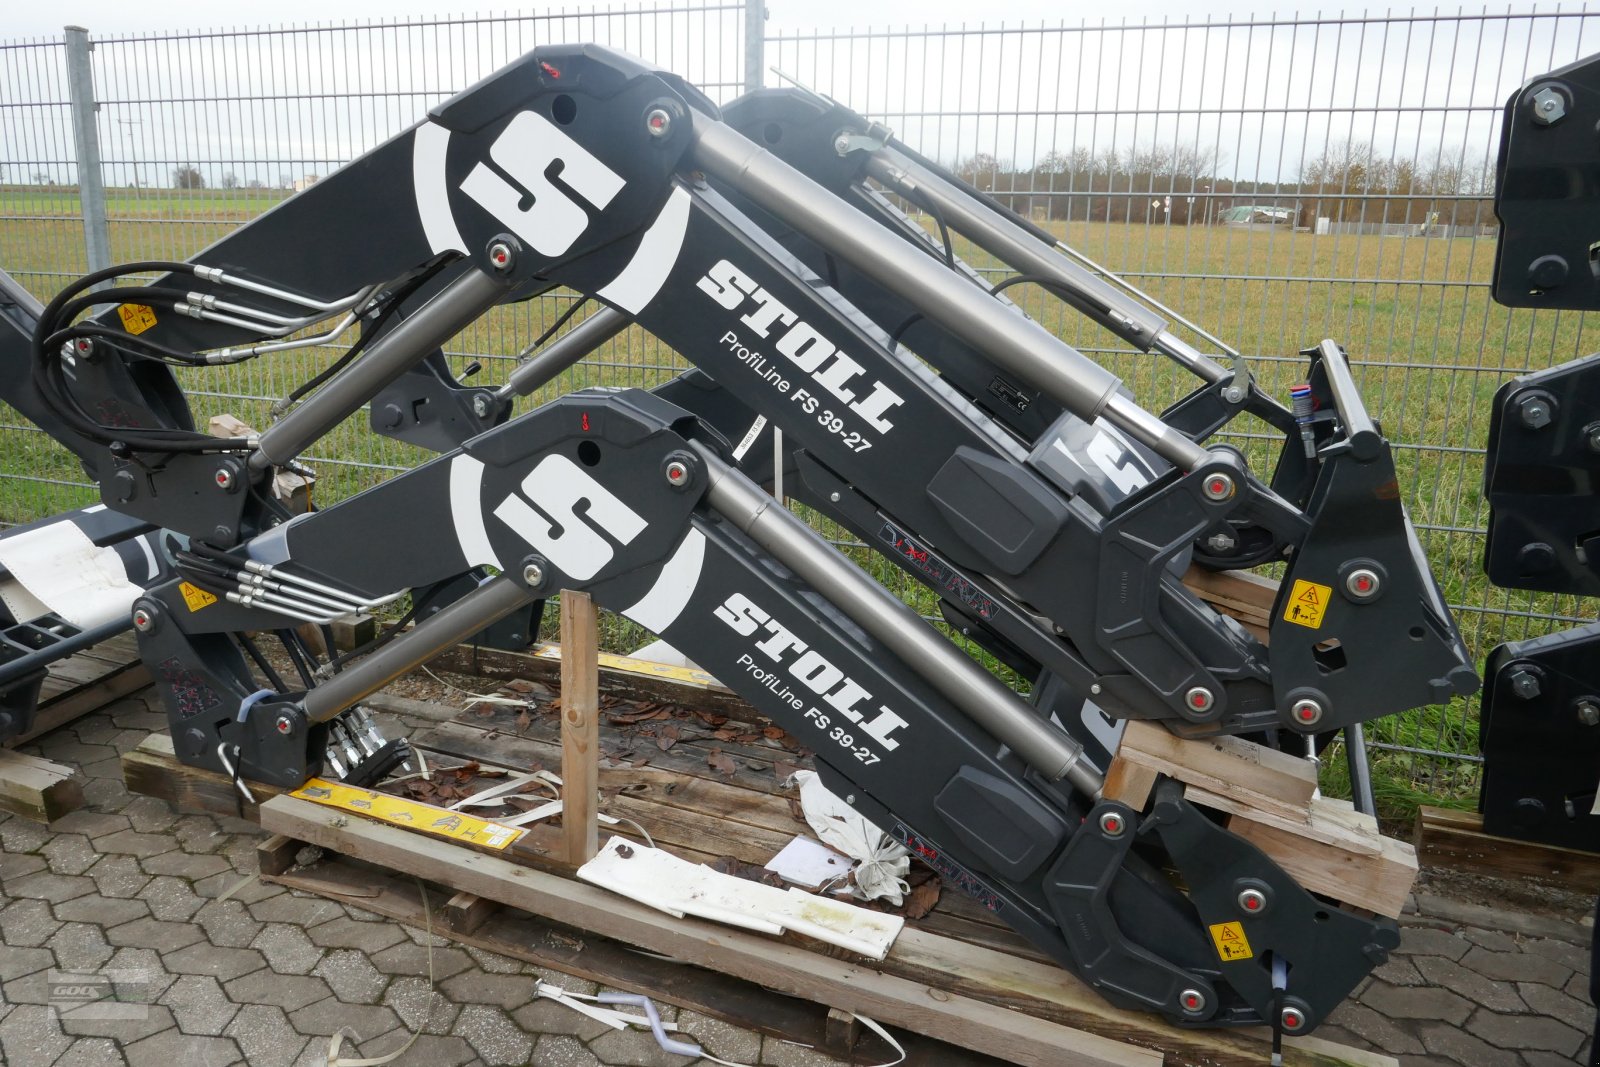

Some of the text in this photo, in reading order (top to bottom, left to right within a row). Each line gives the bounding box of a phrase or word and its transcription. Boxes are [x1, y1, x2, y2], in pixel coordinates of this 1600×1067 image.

[459, 110, 627, 257] S
[695, 259, 905, 435] STOLL
[719, 330, 873, 453] ProfiLine FS 39-27
[493, 453, 649, 581] S
[712, 592, 910, 752] STOLL
[736, 653, 881, 766] ProfiLine FS 39-27
